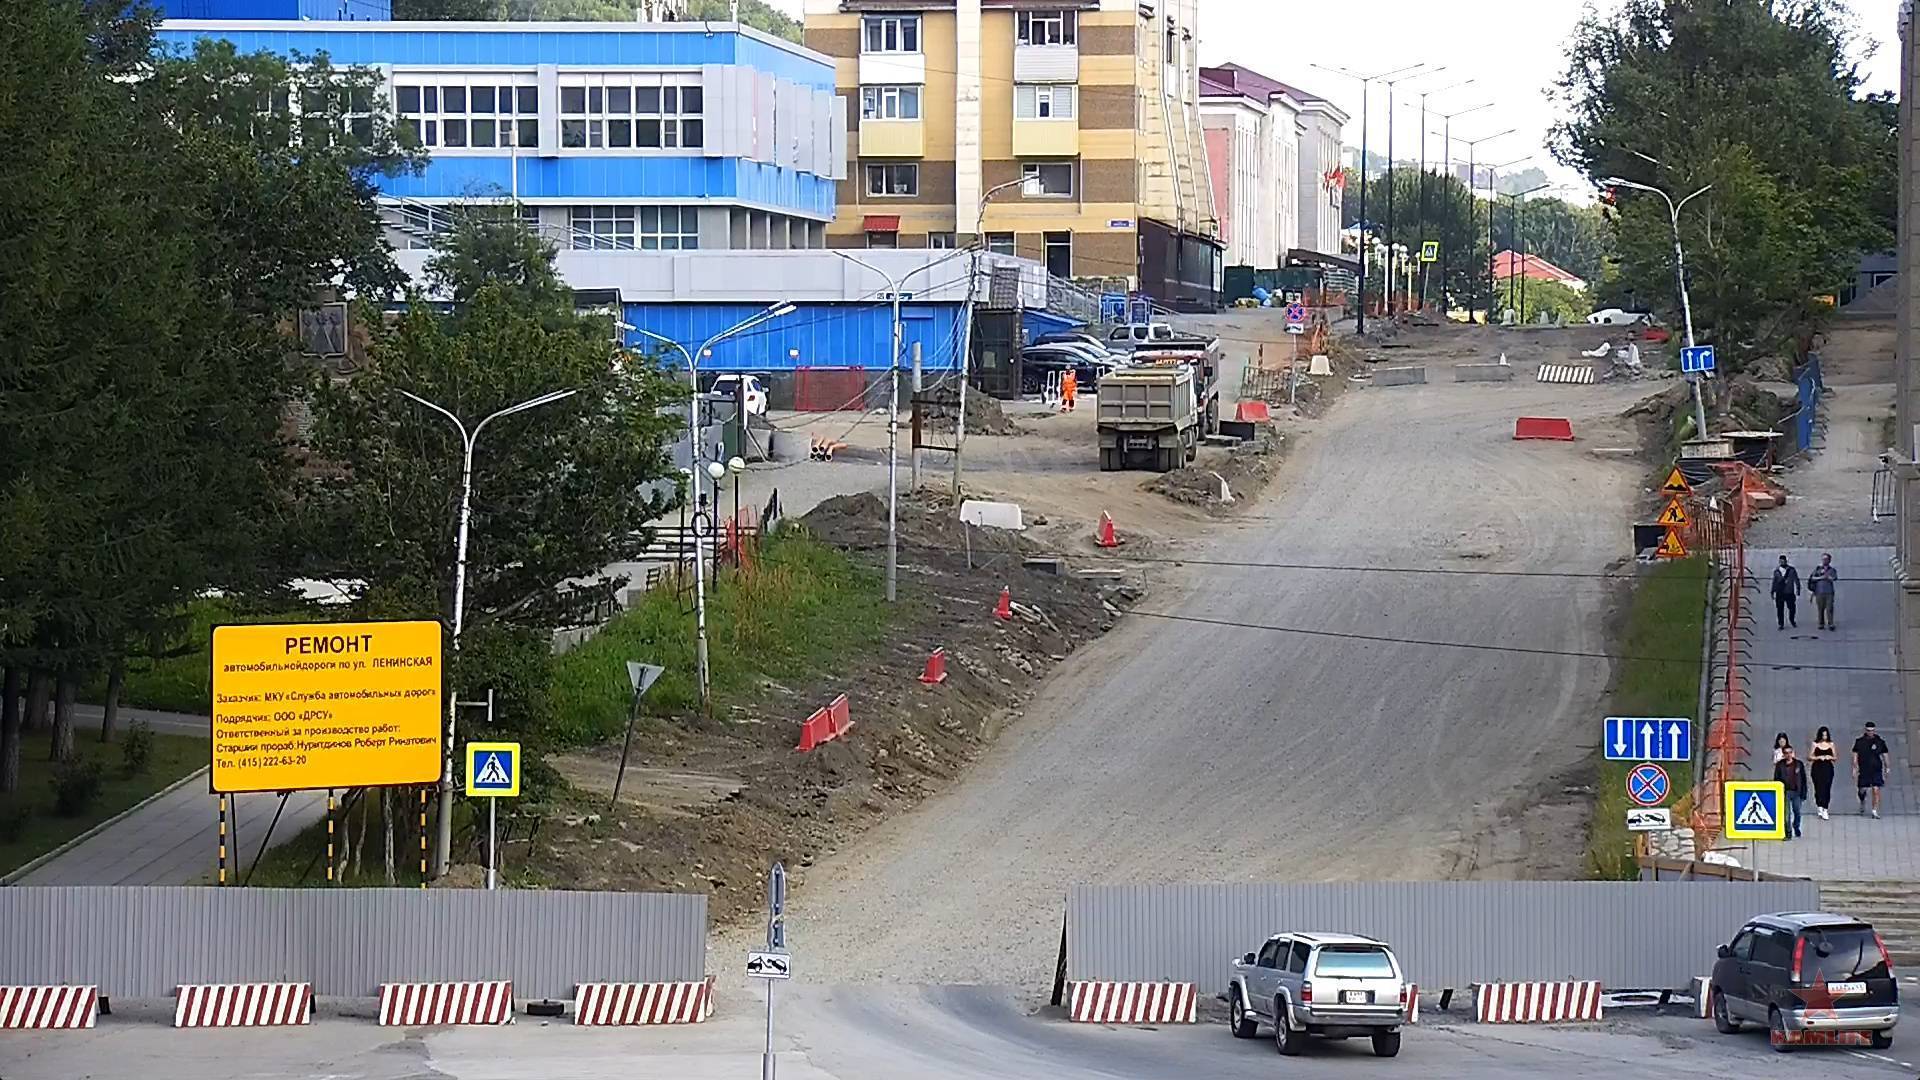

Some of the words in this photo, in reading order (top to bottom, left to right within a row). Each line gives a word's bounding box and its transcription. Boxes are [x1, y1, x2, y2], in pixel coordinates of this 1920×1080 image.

[285, 634, 372, 655] РЕМОНТ
[339, 661, 350, 669] по
[353, 661, 366, 671] ул.
[372, 656, 433, 668] ЛЕНИНСКАЯ
[216, 693, 261, 704] Заказчик:
[264, 692, 285, 702] МКУ
[328, 688, 401, 700] автомобильных
[273, 711, 296, 721] ООО
[298, 710, 333, 721] «ДРСУ»
[216, 727, 290, 739] Ответственный
[292, 728, 302, 736] за
[304, 725, 370, 737] производство
[372, 723, 401, 735] работ:
[216, 744, 258, 754] Старший
[354, 737, 386, 749] Роберт
[388, 736, 437, 746] Ринатович
[216, 758, 235, 769] Тел.
